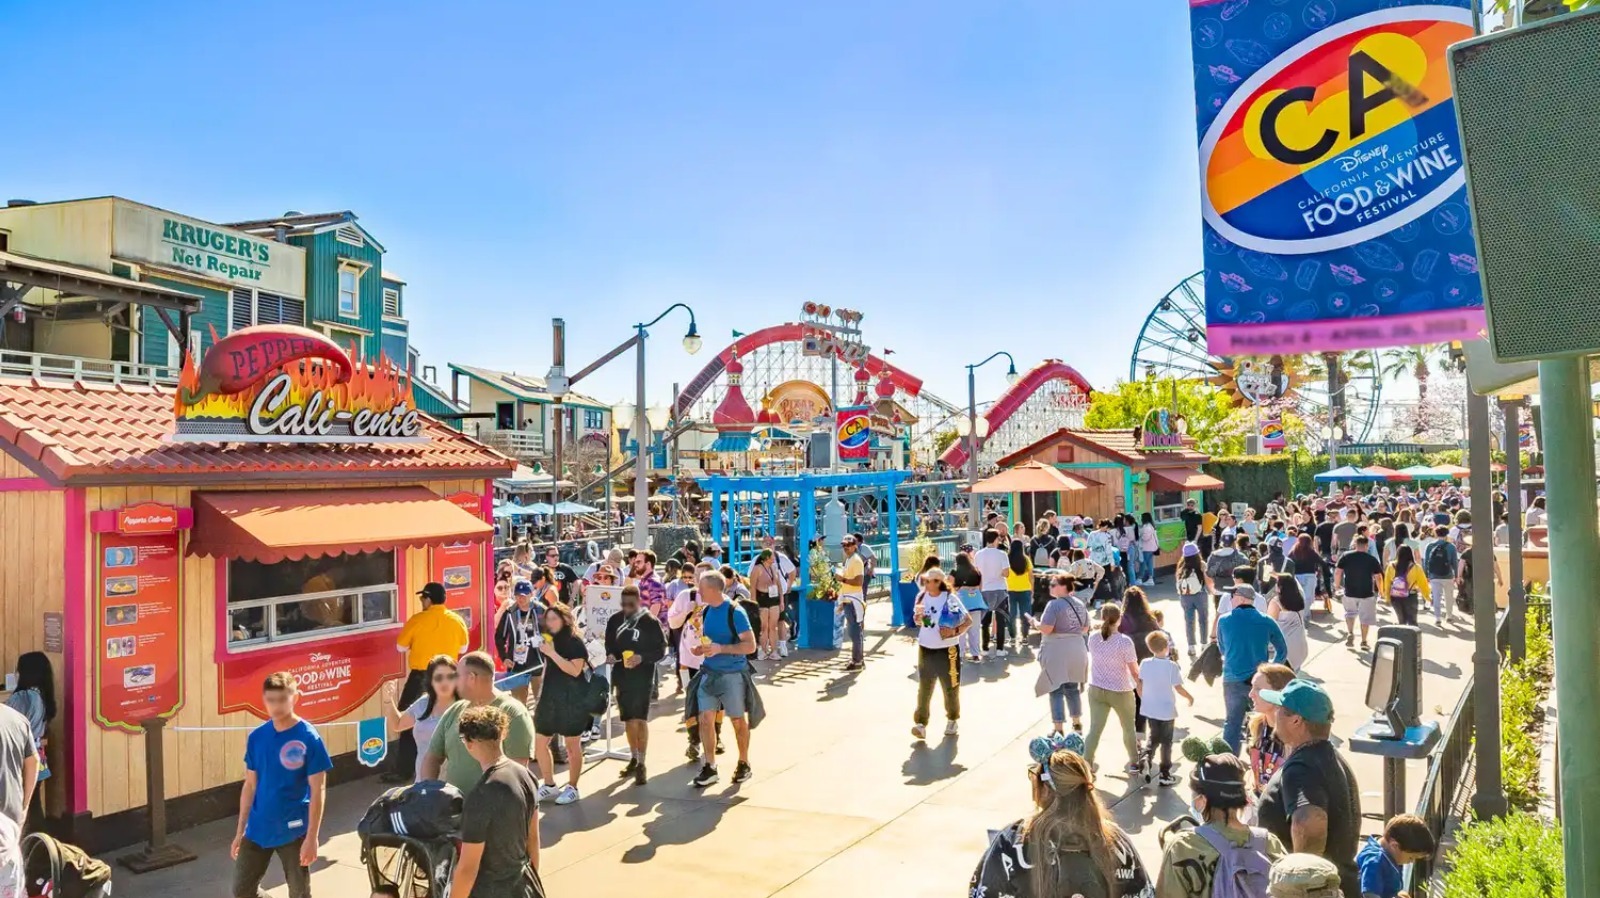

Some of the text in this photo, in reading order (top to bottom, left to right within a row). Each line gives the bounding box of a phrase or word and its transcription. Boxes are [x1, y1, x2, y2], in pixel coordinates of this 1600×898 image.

[1260, 50, 1429, 165] CA
[1298, 132, 1446, 209] CALIFORNIA ADVENTURE
[1302, 143, 1458, 232] FOOD & WINE
[1356, 190, 1417, 223] FESTIVAL
[163, 219, 269, 262] KRUGER'S
[172, 247, 263, 280] Net Repair
[249, 373, 419, 436] Cali-ente
[846, 420, 864, 436] CA
[293, 671, 318, 686] OOD
[325, 664, 351, 679] WINE
